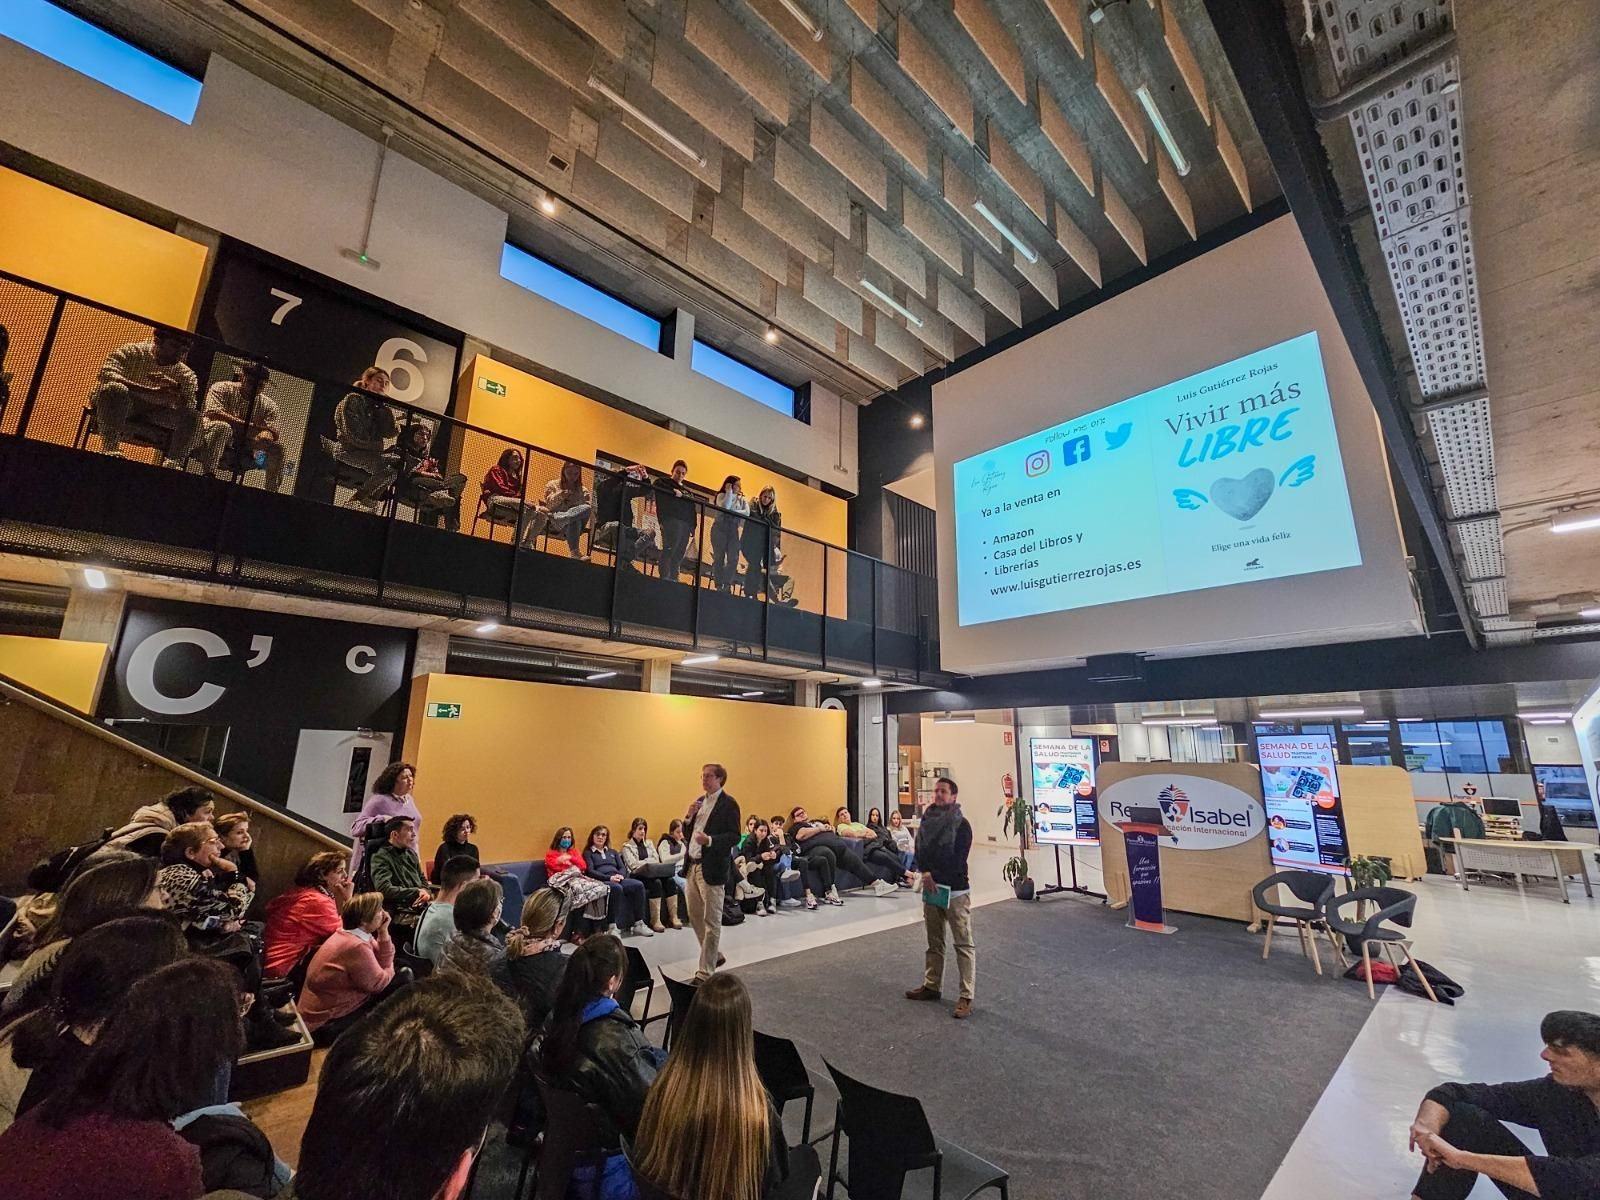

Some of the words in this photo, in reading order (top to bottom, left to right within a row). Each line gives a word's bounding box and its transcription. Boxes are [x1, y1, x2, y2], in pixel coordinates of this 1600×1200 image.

[270, 287, 303, 326] 7
[375, 337, 428, 402] 6
[1176, 390, 1198, 403] Luis
[1199, 373, 1247, 395] Gutiérrez
[1249, 362, 1279, 379] Rojas
[1165, 404, 1231, 435] Vivir
[1238, 380, 1302, 415] más
[1178, 407, 1301, 468] LIBRE
[981, 507, 993, 519] Ya
[994, 505, 1001, 515] a
[1003, 501, 1012, 512] la
[1014, 492, 1044, 508] venta
[1047, 487, 1062, 500] en
[992, 528, 1035, 545] Amazon
[993, 549, 1017, 561] Casa
[1020, 541, 1036, 555] del
[1039, 533, 1073, 551] Libros
[1076, 532, 1084, 544] y
[1211, 542, 1232, 553] Elige
[1233, 539, 1250, 548] una
[1251, 535, 1270, 545] vida
[1272, 531, 1291, 541] feliz
[990, 558, 1142, 597] www.luisgutierrezrojas.es
[994, 558, 1040, 577] Librerías
[1261, 751, 1291, 759] SALUD
[1300, 742, 1314, 750] DE
[1316, 742, 1330, 750] LA
[1189, 806, 1252, 828] Isabel
[1193, 826, 1248, 838] Internacional
